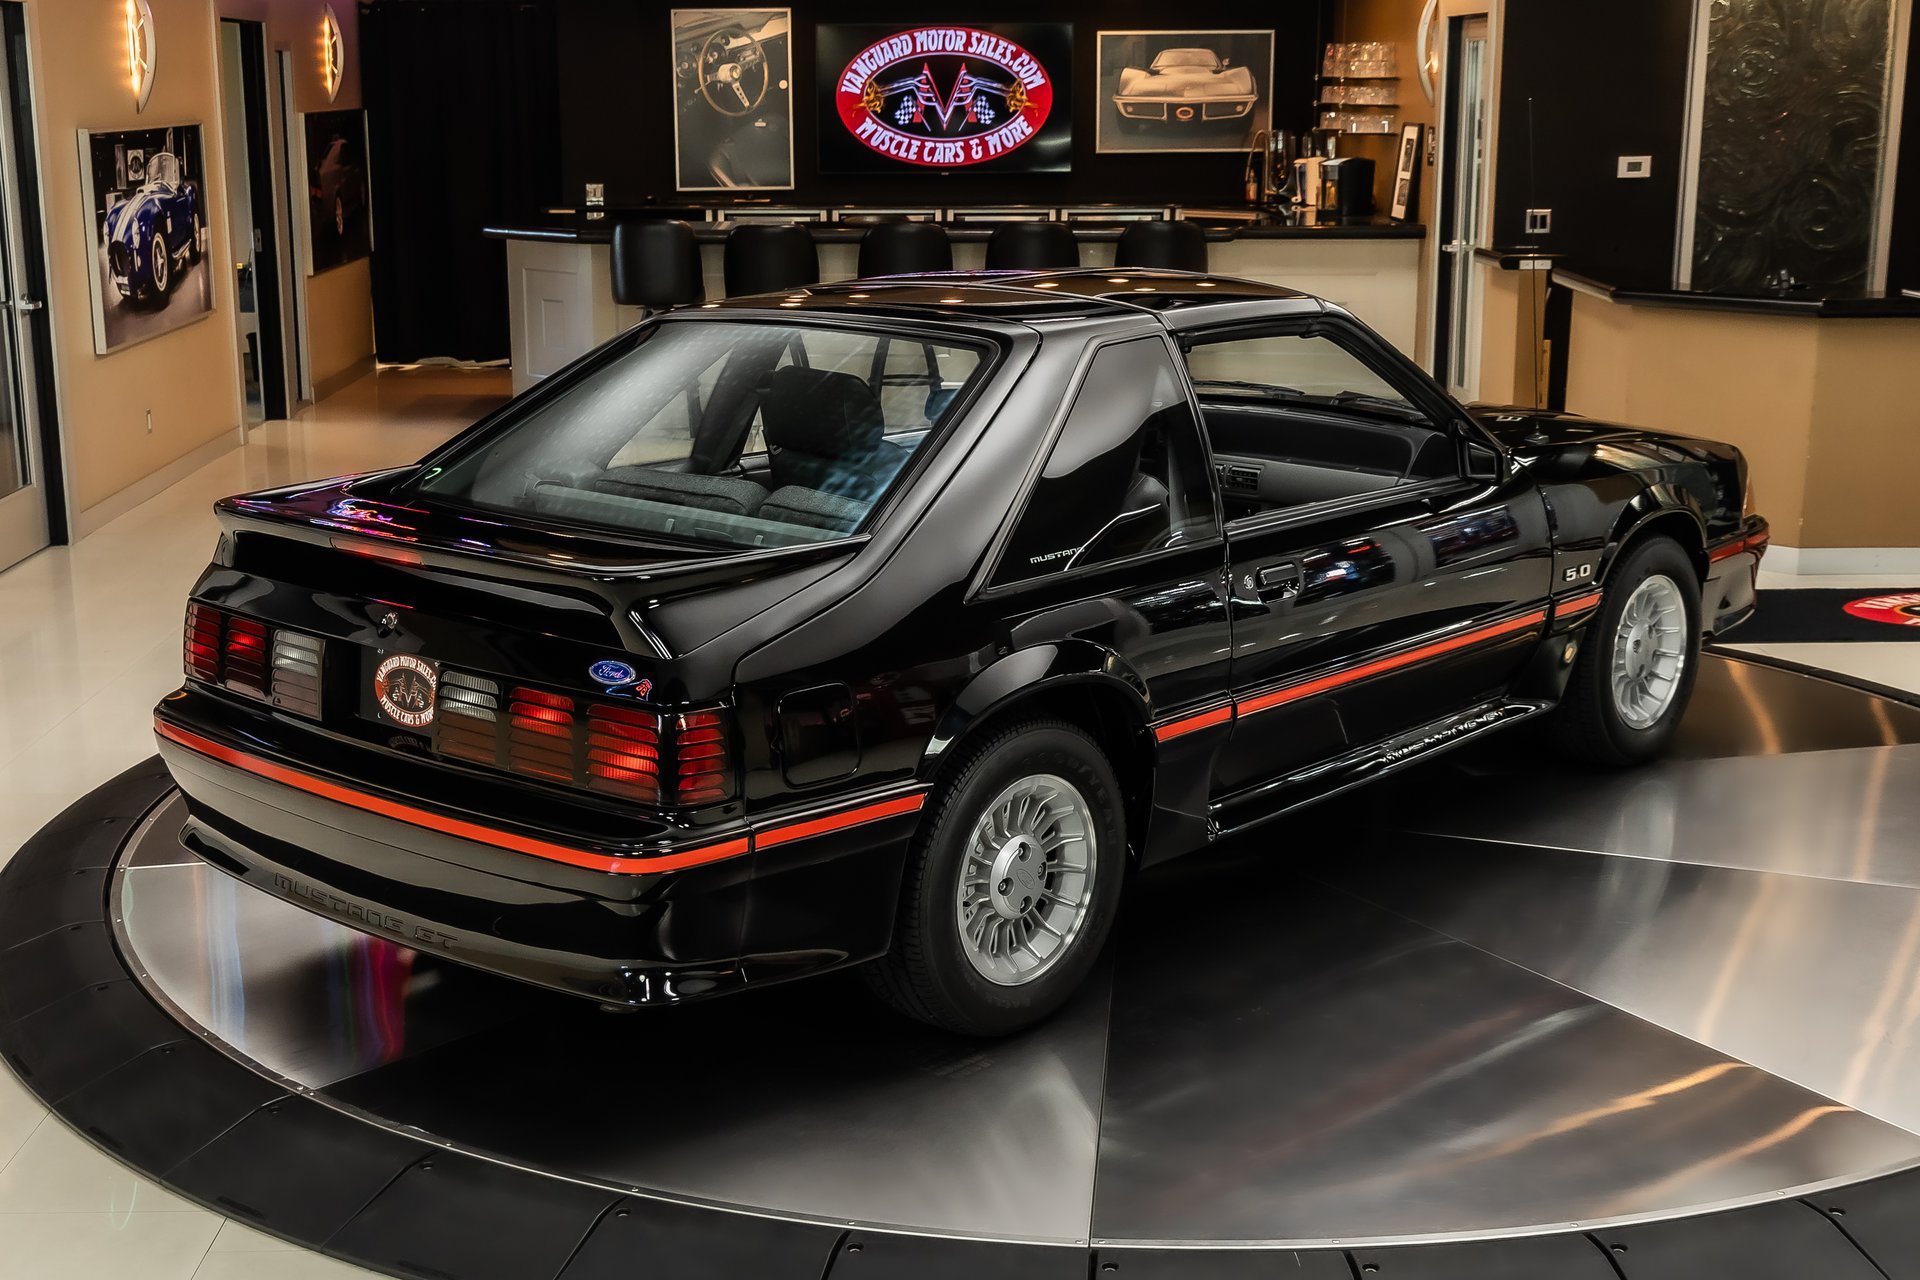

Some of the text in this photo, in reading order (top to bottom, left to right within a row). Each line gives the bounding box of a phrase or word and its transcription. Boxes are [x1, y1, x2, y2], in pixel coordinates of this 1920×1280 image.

[841, 29, 1046, 95] VANGUARD MOTOR SALES.COM
[855, 115, 1034, 163] MUSCLE CARS & MORE
[1565, 563, 1591, 582] 5.0
[377, 656, 399, 682] VANGUARD
[400, 656, 416, 669] MOTOR
[380, 695, 400, 720] MUSCLE
[401, 712, 414, 725] CARS
[275, 872, 458, 949] MUSTANG GT
